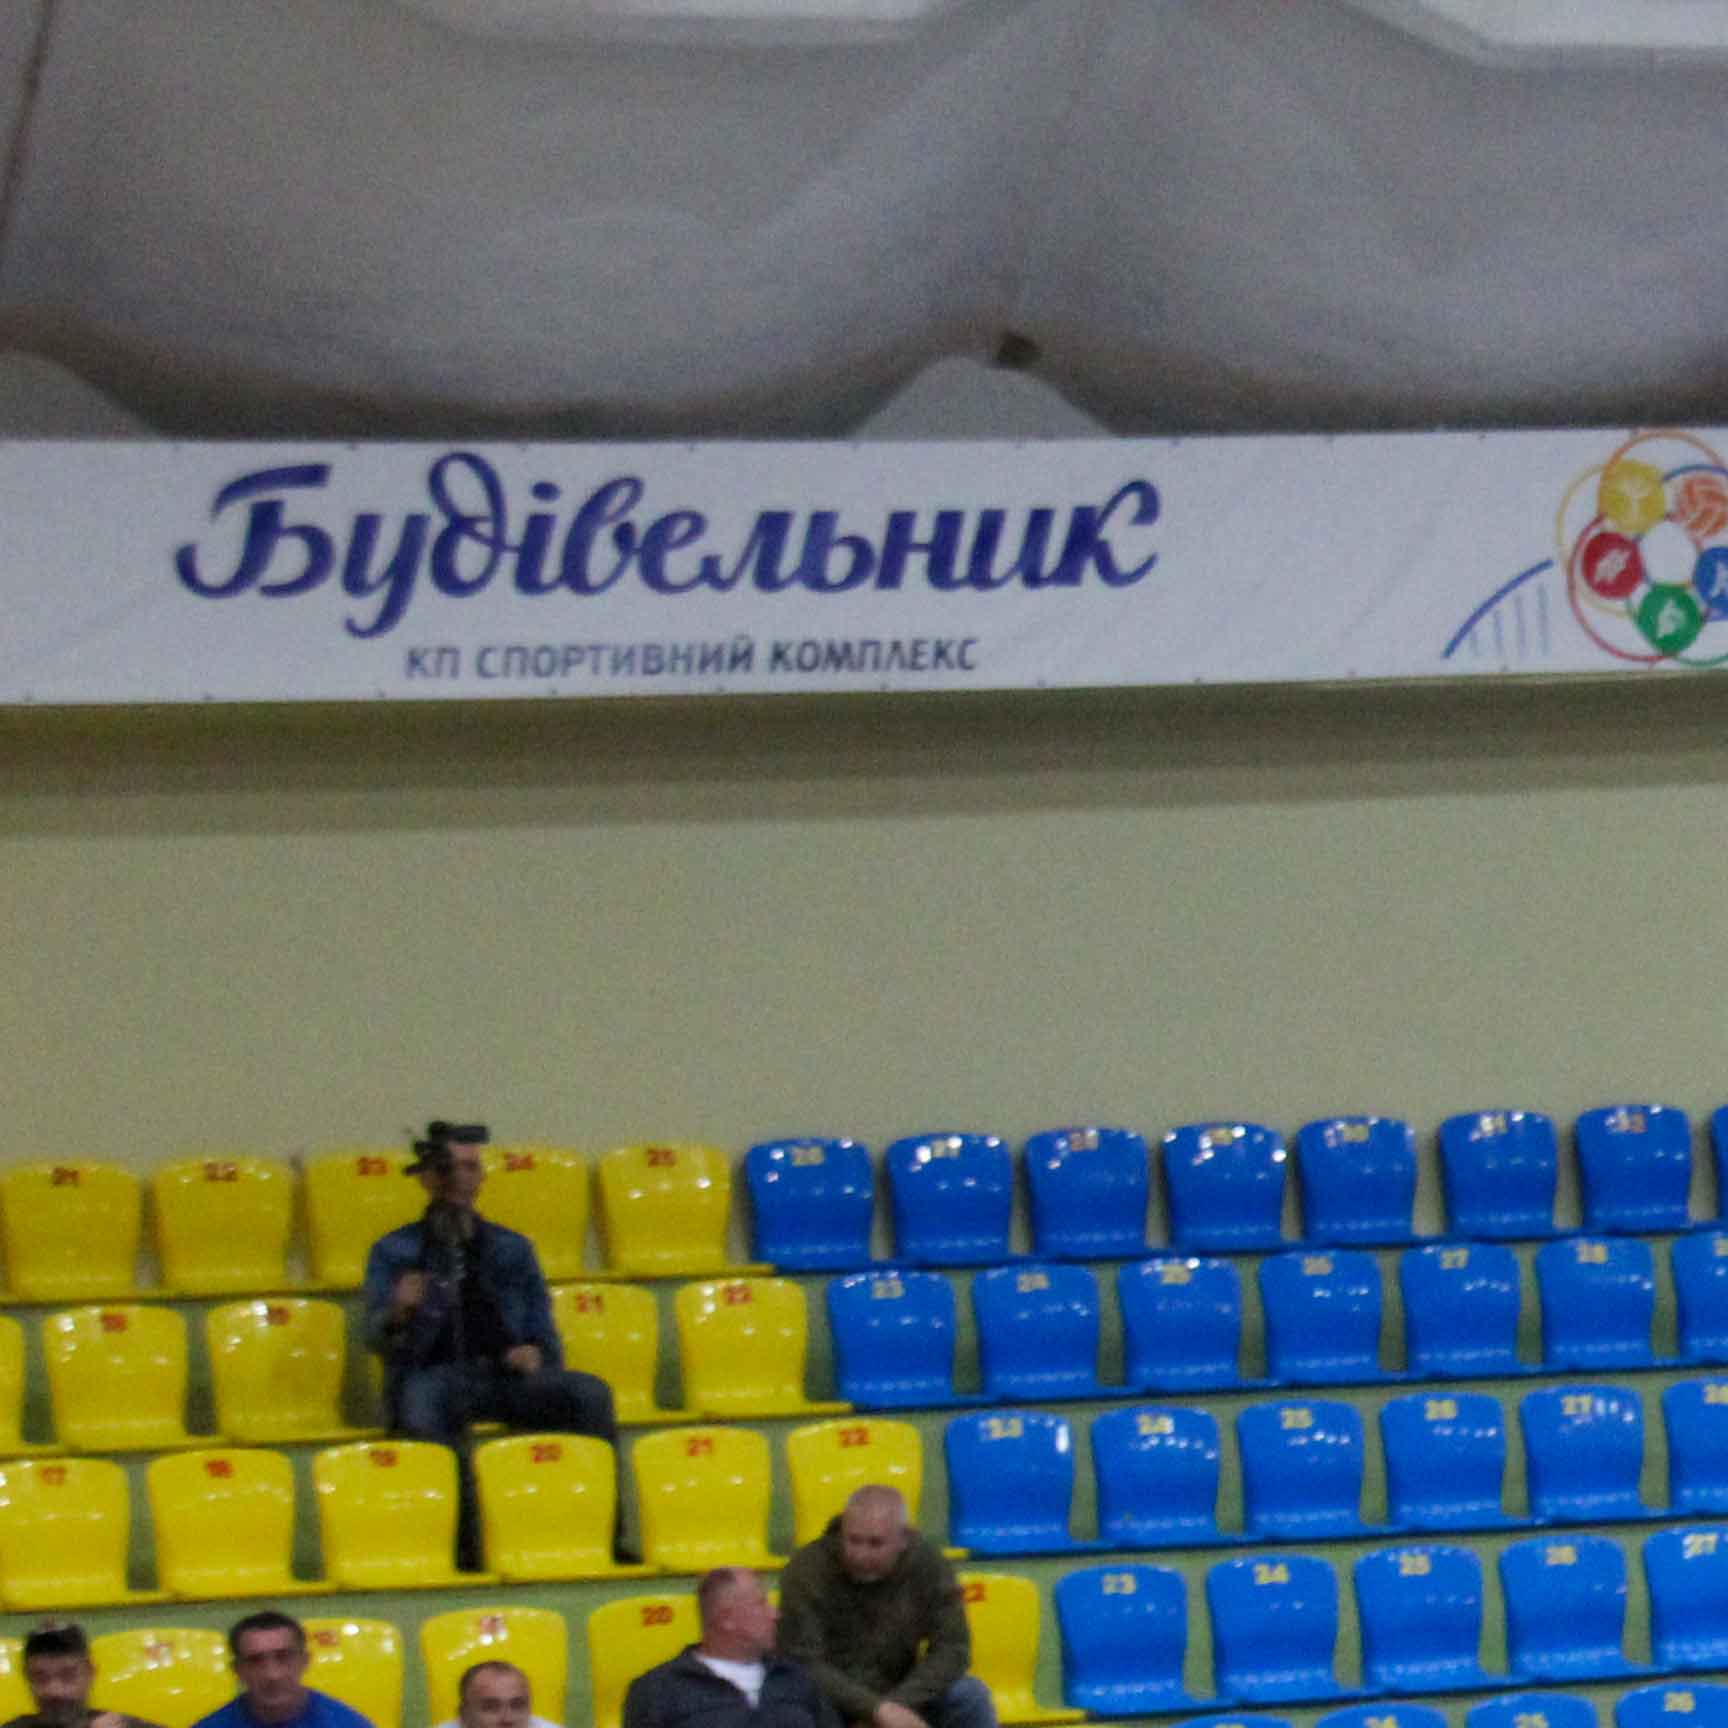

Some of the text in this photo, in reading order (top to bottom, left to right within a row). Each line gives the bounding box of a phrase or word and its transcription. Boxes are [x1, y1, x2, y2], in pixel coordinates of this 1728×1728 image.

[174, 451, 1162, 638] Будівельник
[404, 635, 980, 679] КП СПОРТИВНИЙ КОМПЛЕКС
